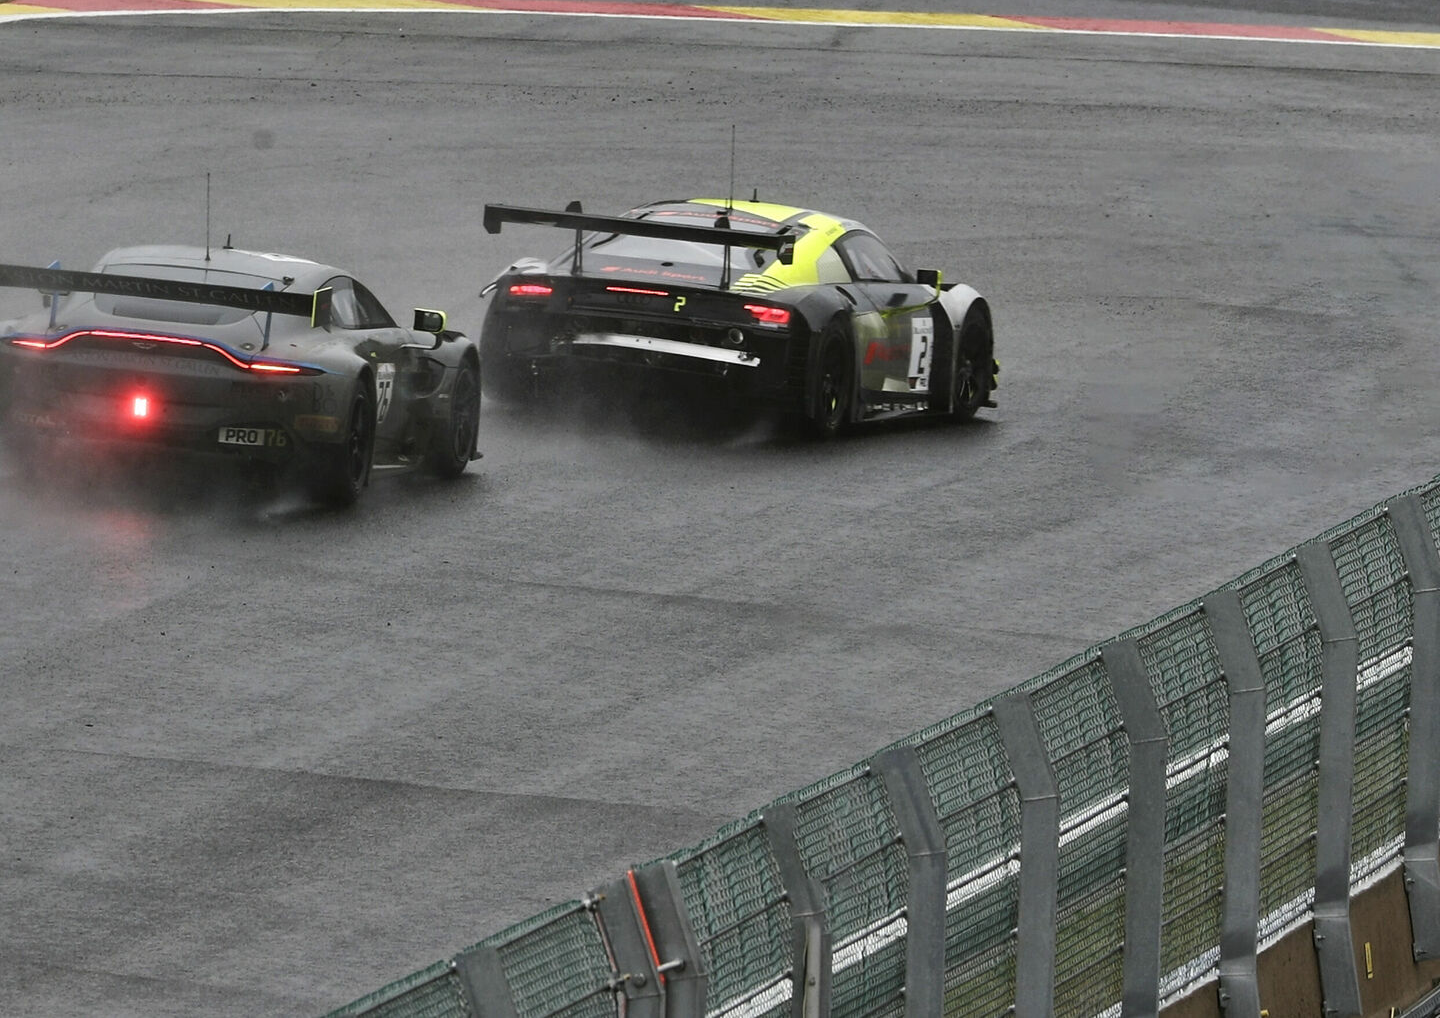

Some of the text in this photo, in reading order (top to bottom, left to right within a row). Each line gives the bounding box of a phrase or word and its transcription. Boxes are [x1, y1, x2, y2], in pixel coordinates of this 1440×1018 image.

[621, 267, 707, 282] Audi Sport
[81, 274, 170, 295] MARTIN
[673, 295, 687, 313] 2
[916, 335, 928, 375] 2
[225, 428, 288, 447] PRO 76
